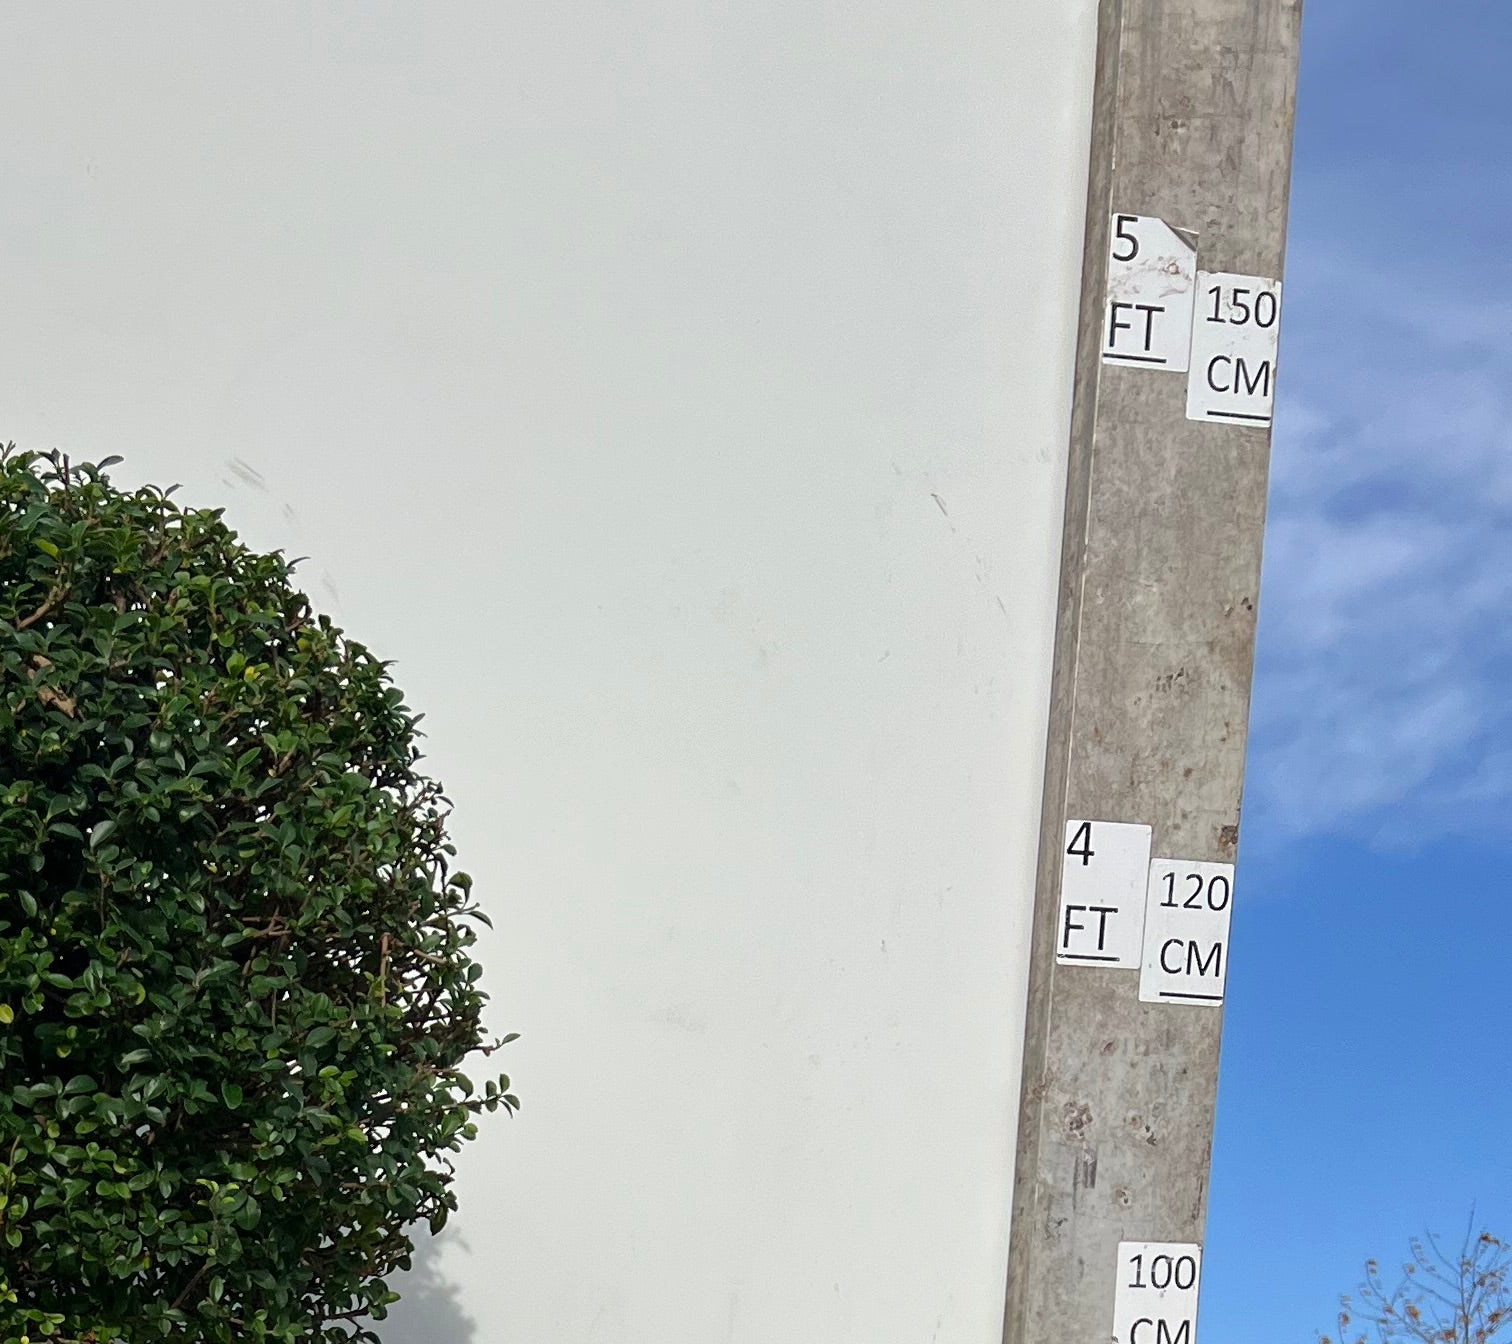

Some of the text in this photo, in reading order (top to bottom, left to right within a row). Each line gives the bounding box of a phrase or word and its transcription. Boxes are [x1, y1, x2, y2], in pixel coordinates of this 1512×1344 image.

[1112, 214, 1139, 262] 5
[1109, 301, 1165, 351] FT
[1206, 285, 1277, 329] 150
[1207, 355, 1270, 397] CM
[1066, 821, 1095, 866] 4
[1160, 870, 1230, 913] 120
[1063, 904, 1119, 951] FT
[1160, 938, 1222, 978] CM
[1128, 1254, 1196, 1290] 100
